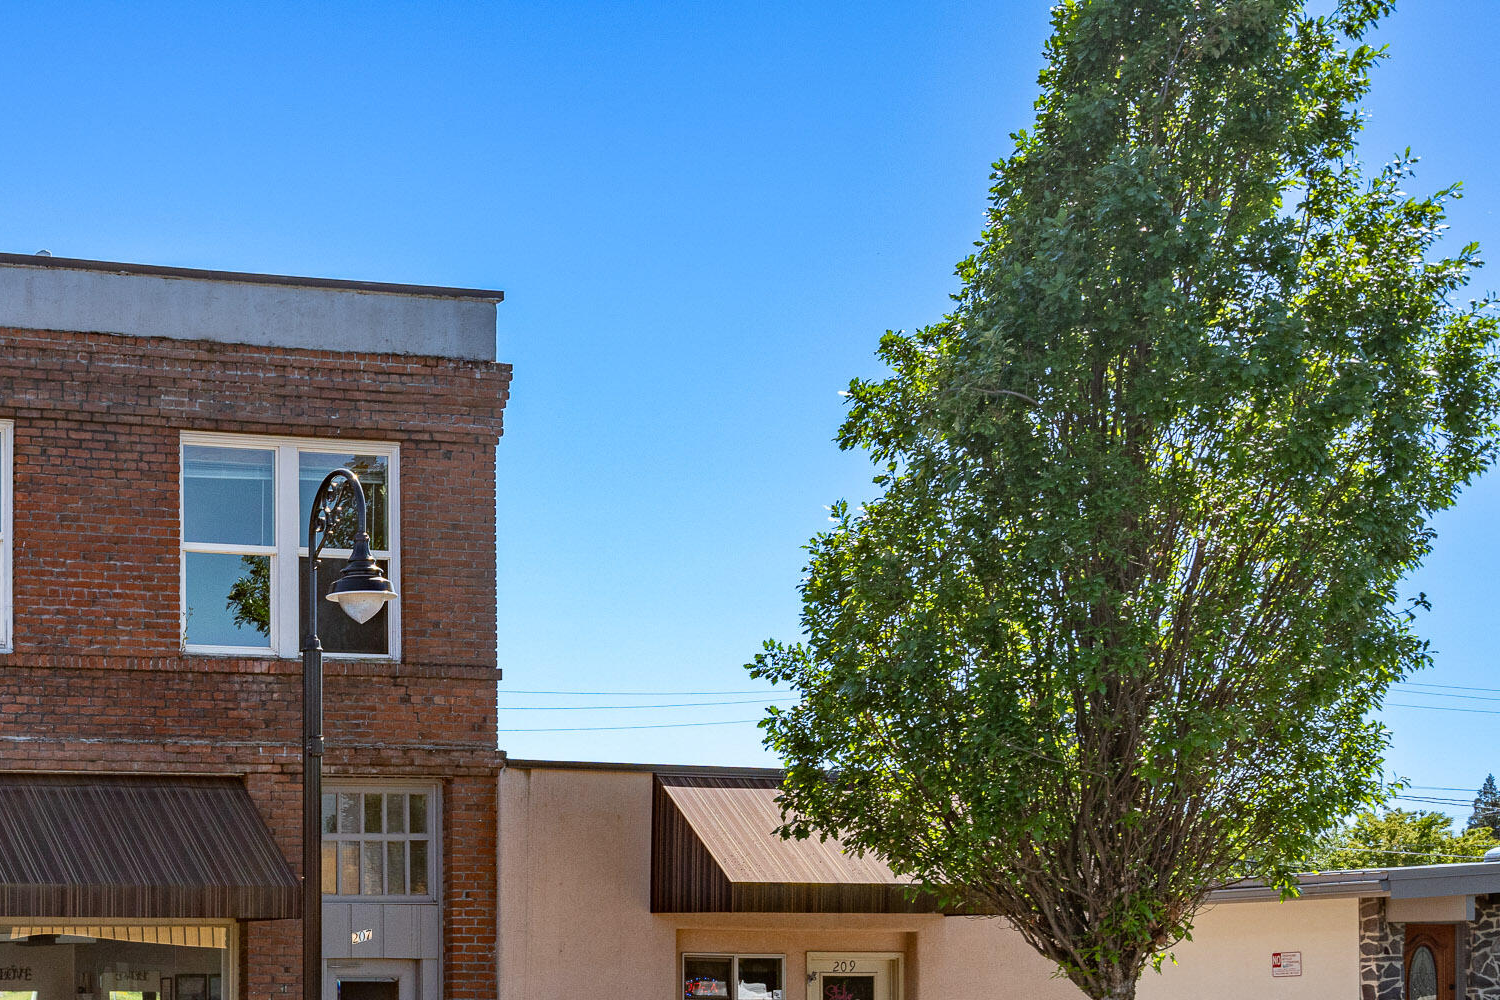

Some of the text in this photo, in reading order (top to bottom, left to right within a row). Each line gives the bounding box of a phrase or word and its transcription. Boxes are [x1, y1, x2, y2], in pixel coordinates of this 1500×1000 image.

[352, 929, 372, 944] 207
[833, 960, 856, 973] 209
[1273, 955, 1281, 965] NO
